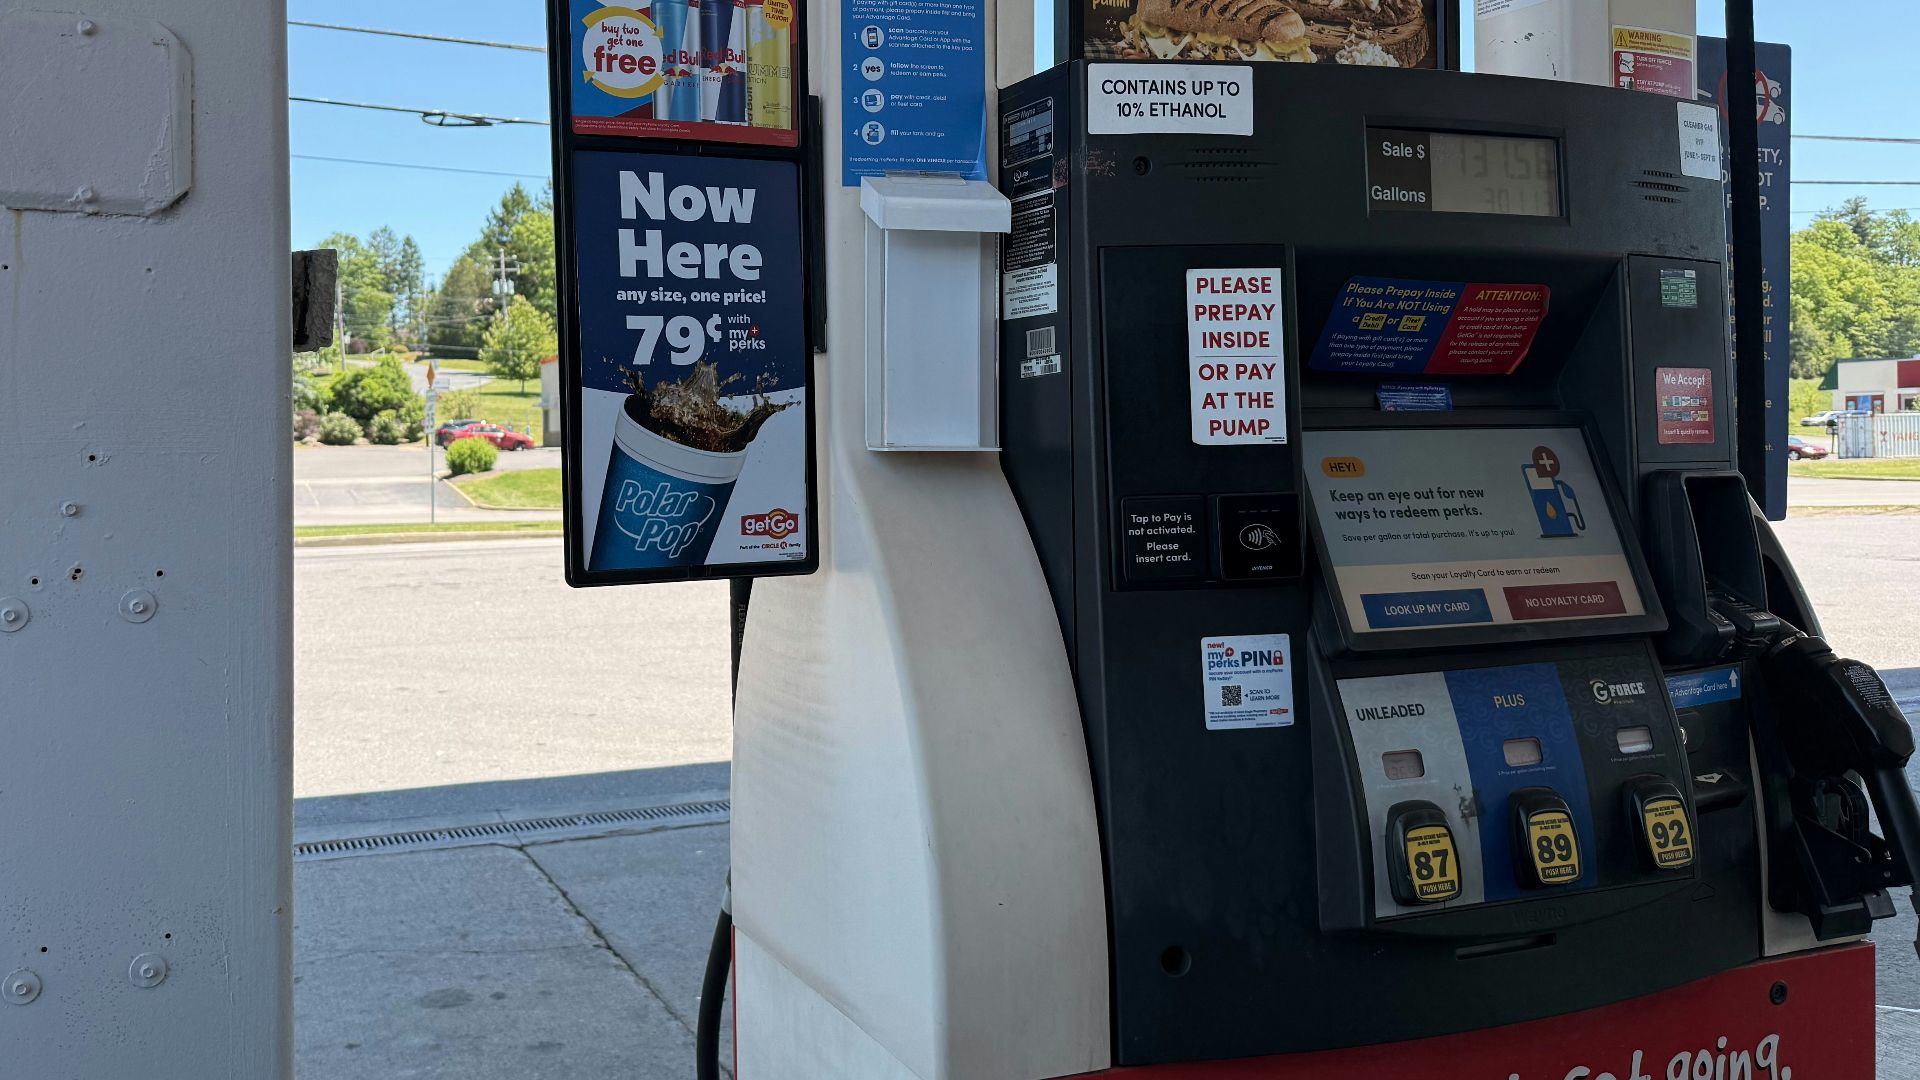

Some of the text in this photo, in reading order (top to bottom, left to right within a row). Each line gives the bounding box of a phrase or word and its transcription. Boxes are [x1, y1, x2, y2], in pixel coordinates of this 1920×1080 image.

[765, 13, 789, 23] FLAVOR!
[771, 7, 784, 15] TIME
[602, 22, 640, 37] buy two
[1628, 30, 1662, 43] WARNING
[607, 35, 644, 50] get one
[594, 46, 656, 75] free
[679, 50, 701, 65] Bull
[701, 47, 746, 63] Red Bull
[865, 65, 881, 74] yes
[1101, 79, 1240, 96] CONTAINS UP TO
[1116, 102, 1227, 118] 10% ETHANOL
[1382, 141, 1425, 159] Sale $
[619, 170, 757, 224] Now
[1371, 185, 1426, 203] Gallons
[617, 228, 763, 281] Here
[1196, 276, 1272, 294] PLEASE
[1346, 282, 1456, 299] Please Prepay Inside
[616, 287, 767, 305] any size, one price!
[1476, 290, 1542, 301] ATTENTION:
[1194, 303, 1276, 322] PREPAY
[1342, 297, 1451, 315] If You Are NOT Using
[727, 314, 751, 324] with
[1364, 314, 1384, 322] Credit
[1387, 317, 1399, 325] or
[728, 329, 749, 340] my
[1202, 331, 1270, 349] INSIDE
[729, 338, 766, 351] perks
[1198, 362, 1277, 381] OR PAY
[1663, 373, 1705, 388] We Accept
[1201, 391, 1275, 410] AT THE
[1209, 418, 1270, 437] PUMP
[1329, 462, 1357, 472] HEY!
[616, 480, 699, 517] Polar
[1329, 487, 1484, 504] Keep an eye out for new
[1131, 512, 1192, 525] Tap to Pay is
[1335, 504, 1483, 523] ways to redeem perks.
[745, 515, 795, 534] getGo
[1128, 525, 1196, 536] not activated.
[635, 518, 700, 558] Pop
[1342, 533, 1362, 542] Save
[1363, 534, 1376, 543] per
[1378, 532, 1402, 543] gallon
[1412, 531, 1430, 540] total
[1431, 529, 1468, 541] purchase.
[1481, 529, 1490, 538] up
[1491, 528, 1499, 537] to
[1499, 527, 1515, 538] you!
[780, 541, 788, 549] K
[1146, 542, 1179, 551] Please
[1135, 552, 1192, 563] insert card.
[1411, 572, 1431, 581] Scan
[1432, 572, 1449, 582] your
[1449, 570, 1476, 580] Loyalty
[1477, 569, 1496, 578] Card
[1505, 568, 1523, 576] earn
[1533, 566, 1561, 575] redeem
[1384, 601, 1470, 616] LOOK UP MY CARD
[1525, 594, 1605, 608] NO LOYALTY CARD
[1207, 651, 1224, 660] my
[1208, 650, 1272, 670] perks PIN
[1608, 681, 1646, 698] FORCE
[1674, 686, 1702, 697] Advantage
[1703, 682, 1716, 692] Card
[1717, 682, 1728, 690] here
[1493, 693, 1525, 709] PLUS
[1355, 703, 1425, 721] UNLEADED
[1652, 819, 1688, 849] 92
[1537, 833, 1572, 864] 89
[1414, 848, 1449, 881] 87
[1422, 884, 1438, 893] PUSH
